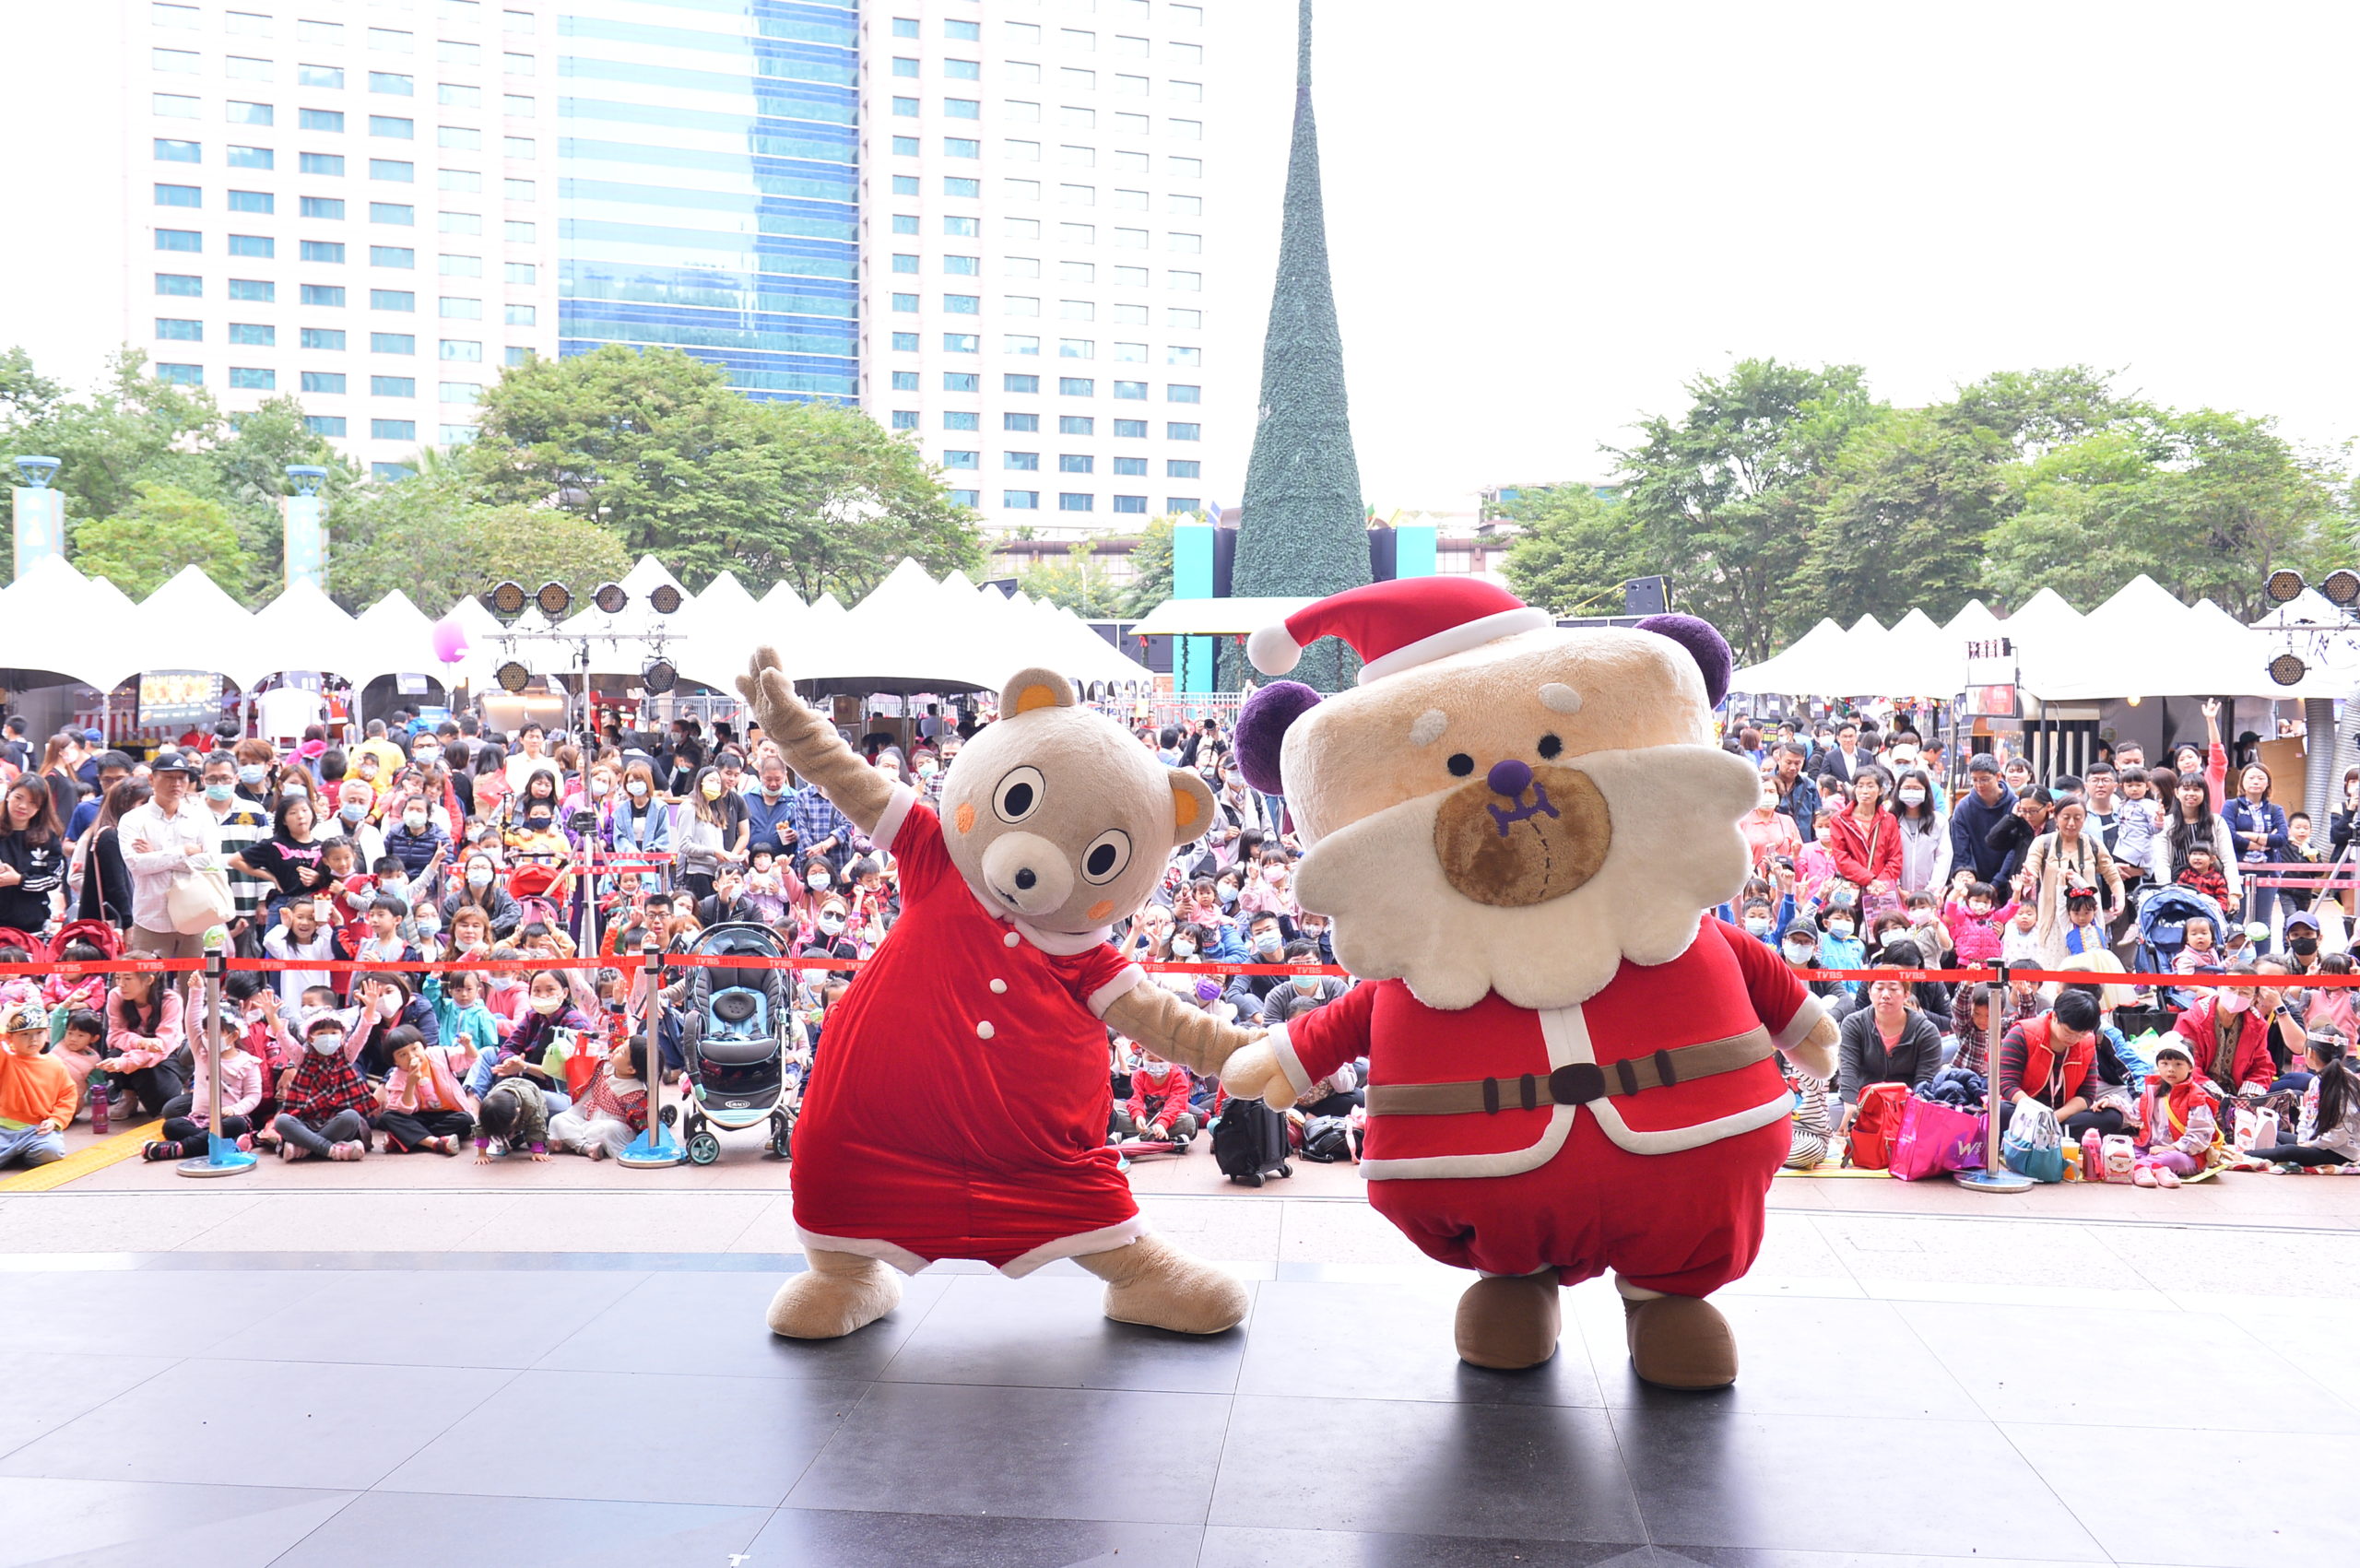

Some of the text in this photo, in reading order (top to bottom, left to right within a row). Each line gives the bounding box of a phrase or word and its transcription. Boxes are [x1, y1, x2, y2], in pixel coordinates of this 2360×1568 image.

[136, 961, 165, 970] TVBS
[695, 957, 720, 965] TVBS
[768, 959, 794, 968] TVBS
[844, 961, 867, 970] TVB
[53, 963, 82, 973] TVBS
[1216, 965, 1243, 973] TVBS
[1296, 966, 1322, 974] TVBS
[1816, 971, 1844, 979] TVBS
[1899, 971, 1927, 980] TVBS
